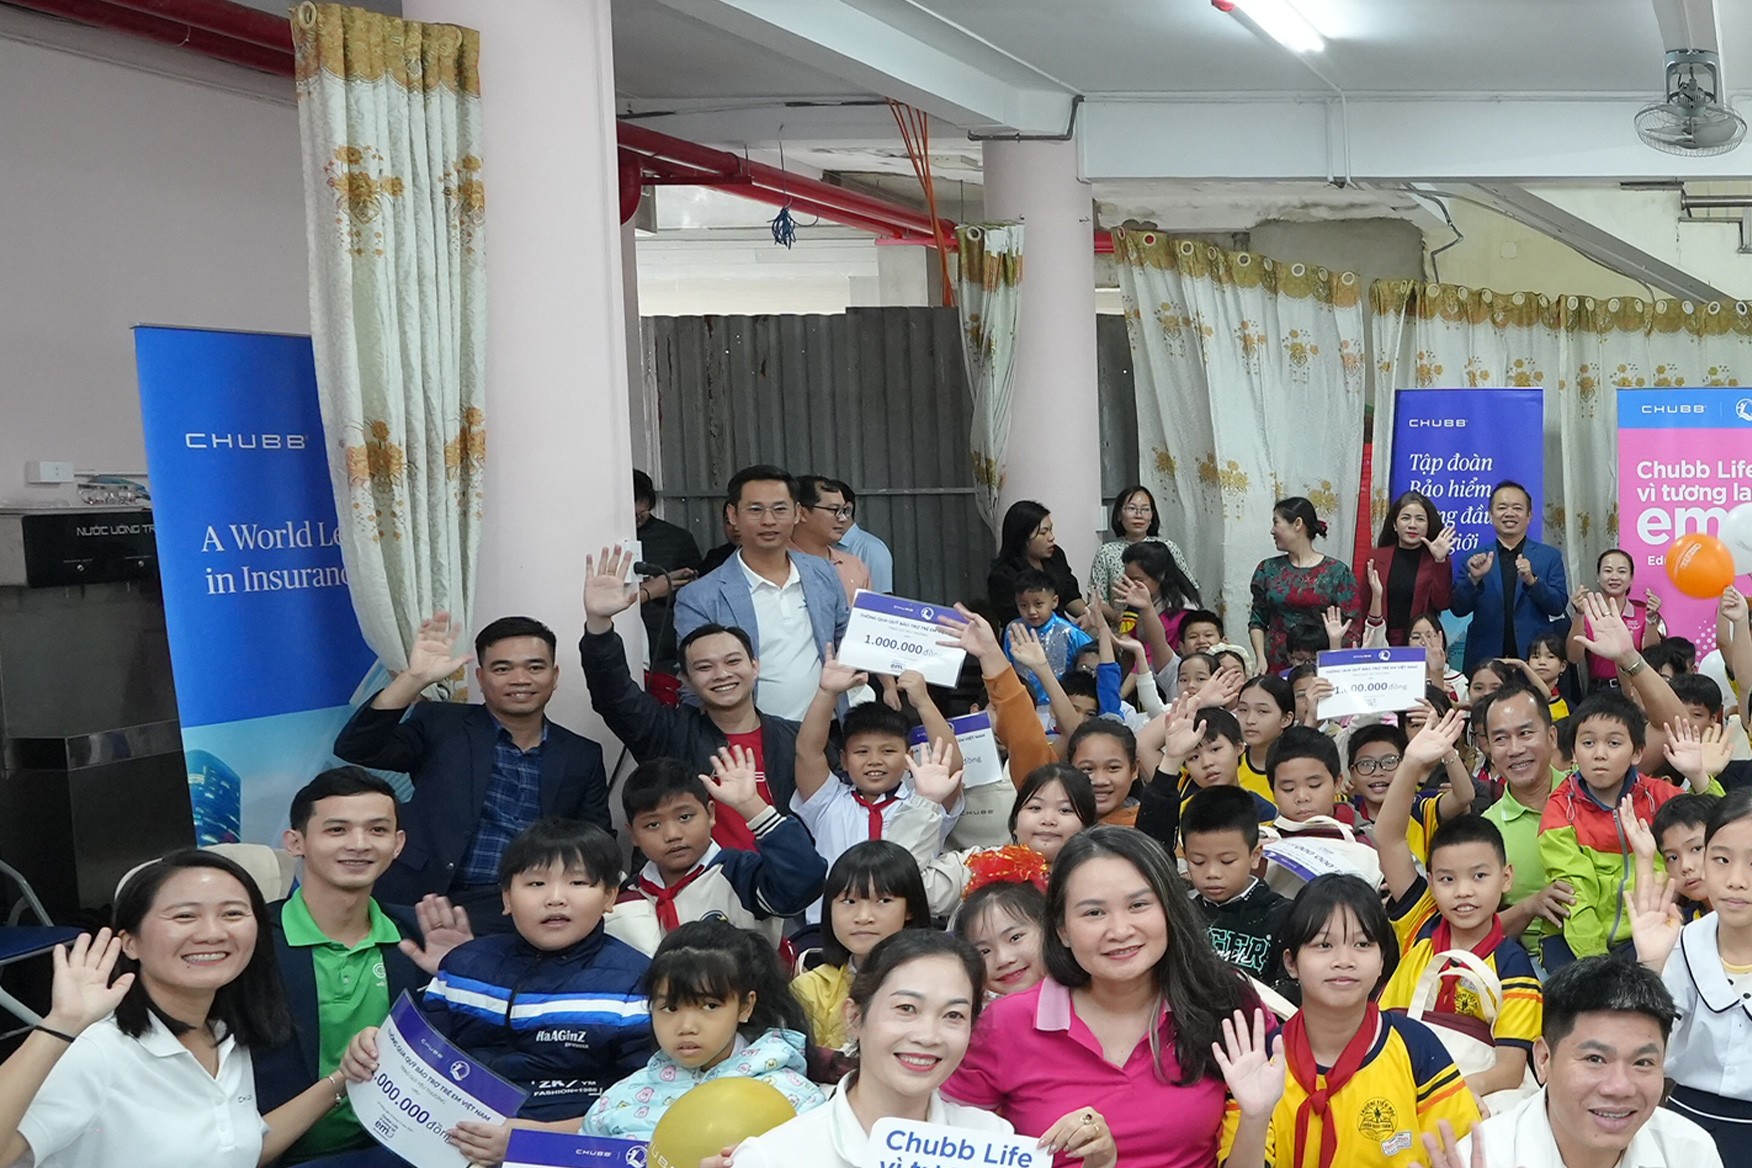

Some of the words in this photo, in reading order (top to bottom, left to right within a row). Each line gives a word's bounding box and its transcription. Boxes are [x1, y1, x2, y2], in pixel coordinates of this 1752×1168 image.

[1641, 405, 1705, 413] CHUBB
[1409, 419, 1466, 427] CHUBB
[185, 433, 306, 449] CHUBB
[1409, 454, 1443, 475] Tập
[1447, 453, 1493, 471] đoàn
[1636, 460, 1710, 479] Chubb
[1410, 478, 1443, 497] Bảo
[1448, 477, 1491, 498] hiểm
[1637, 483, 1655, 501] vì
[1662, 483, 1727, 505] tương
[1437, 511, 1458, 528] ng
[1636, 507, 1730, 545] em
[202, 525, 225, 551] A
[229, 521, 313, 550] World
[205, 567, 236, 594] in
[864, 635, 923, 655] 1.000.000
[1335, 682, 1388, 694] 1.00.000
[576, 1148, 612, 1157] CHUBB
[886, 1130, 975, 1160] Chubb
[984, 1143, 1032, 1168] Life
